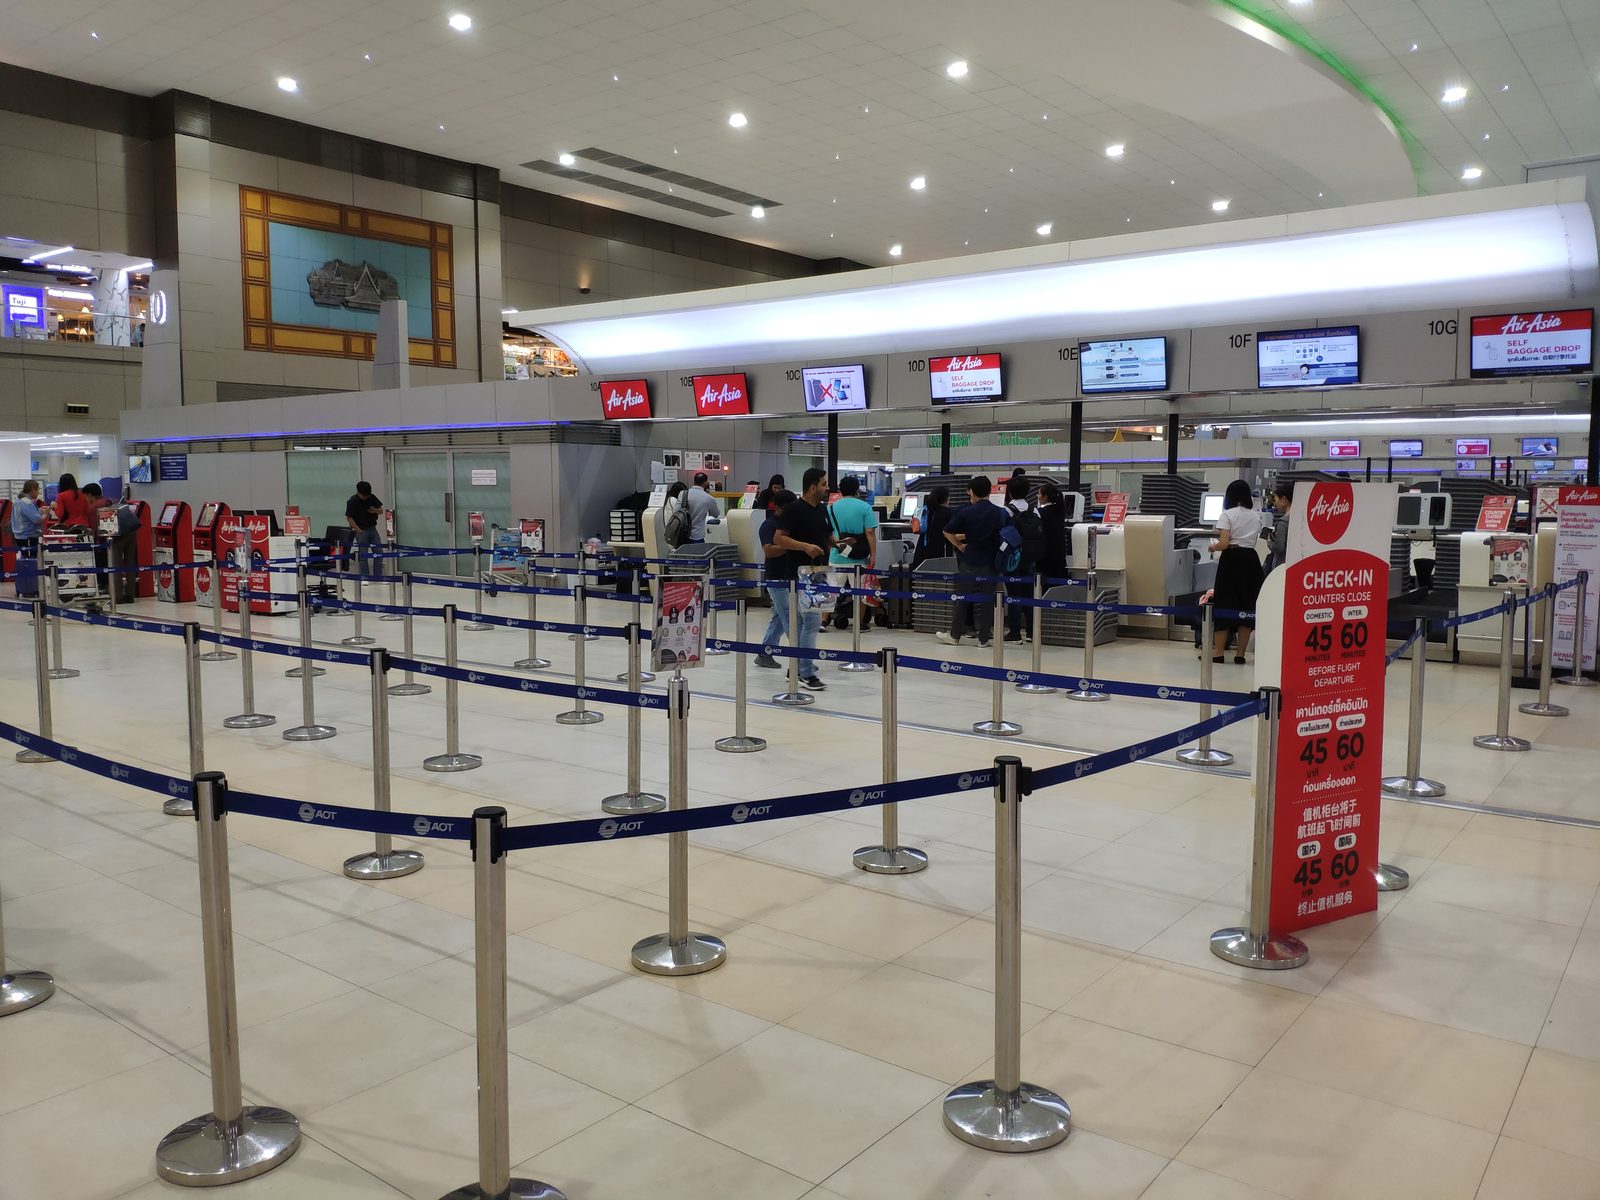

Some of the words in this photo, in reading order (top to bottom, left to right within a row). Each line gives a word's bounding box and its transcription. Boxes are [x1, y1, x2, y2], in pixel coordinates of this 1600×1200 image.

[1428, 320, 1457, 337] 10G
[1229, 333, 1252, 349] 10F
[1507, 339, 1529, 347] SELF
[1057, 347, 1078, 361] 10E
[1507, 347, 1552, 355] BAGGAGE
[1554, 344, 1581, 353] DROP
[908, 359, 926, 372] 10D
[785, 369, 801, 381] 10C
[1303, 568, 1373, 590] CHECK-IN
[1302, 592, 1345, 606] COUNTERS
[1346, 591, 1372, 602] CLOSE
[1306, 611, 1332, 620] DOMESTIC
[1347, 609, 1362, 617] INTER
[1304, 624, 1332, 652] 45
[1341, 622, 1368, 650] 60
[427, 665, 437, 673] AOT
[1308, 664, 1336, 677] BEFORE
[1337, 662, 1361, 673] FLIGHT
[475, 674, 485, 682] AOT
[1314, 675, 1355, 688] DEPARTURE
[586, 690, 597, 698] AOT
[1170, 690, 1186, 698] AOT
[647, 697, 660, 705] AOT
[1299, 737, 1328, 766] 45
[1336, 732, 1364, 760] 60
[119, 770, 130, 779] AOT
[972, 773, 992, 784] AOT
[176, 785, 189, 794] AOT
[864, 790, 886, 800] AOT
[314, 809, 337, 821] AOT
[749, 805, 773, 816] AOT
[1303, 799, 1358, 823] 值机柜台将于
[431, 822, 454, 832] AOT
[618, 821, 644, 832] AOT
[1297, 813, 1361, 839] 航班起飞时间前
[1294, 858, 1322, 887] 45
[1330, 851, 1359, 879] 60
[1297, 890, 1353, 917] 终止值机服务
